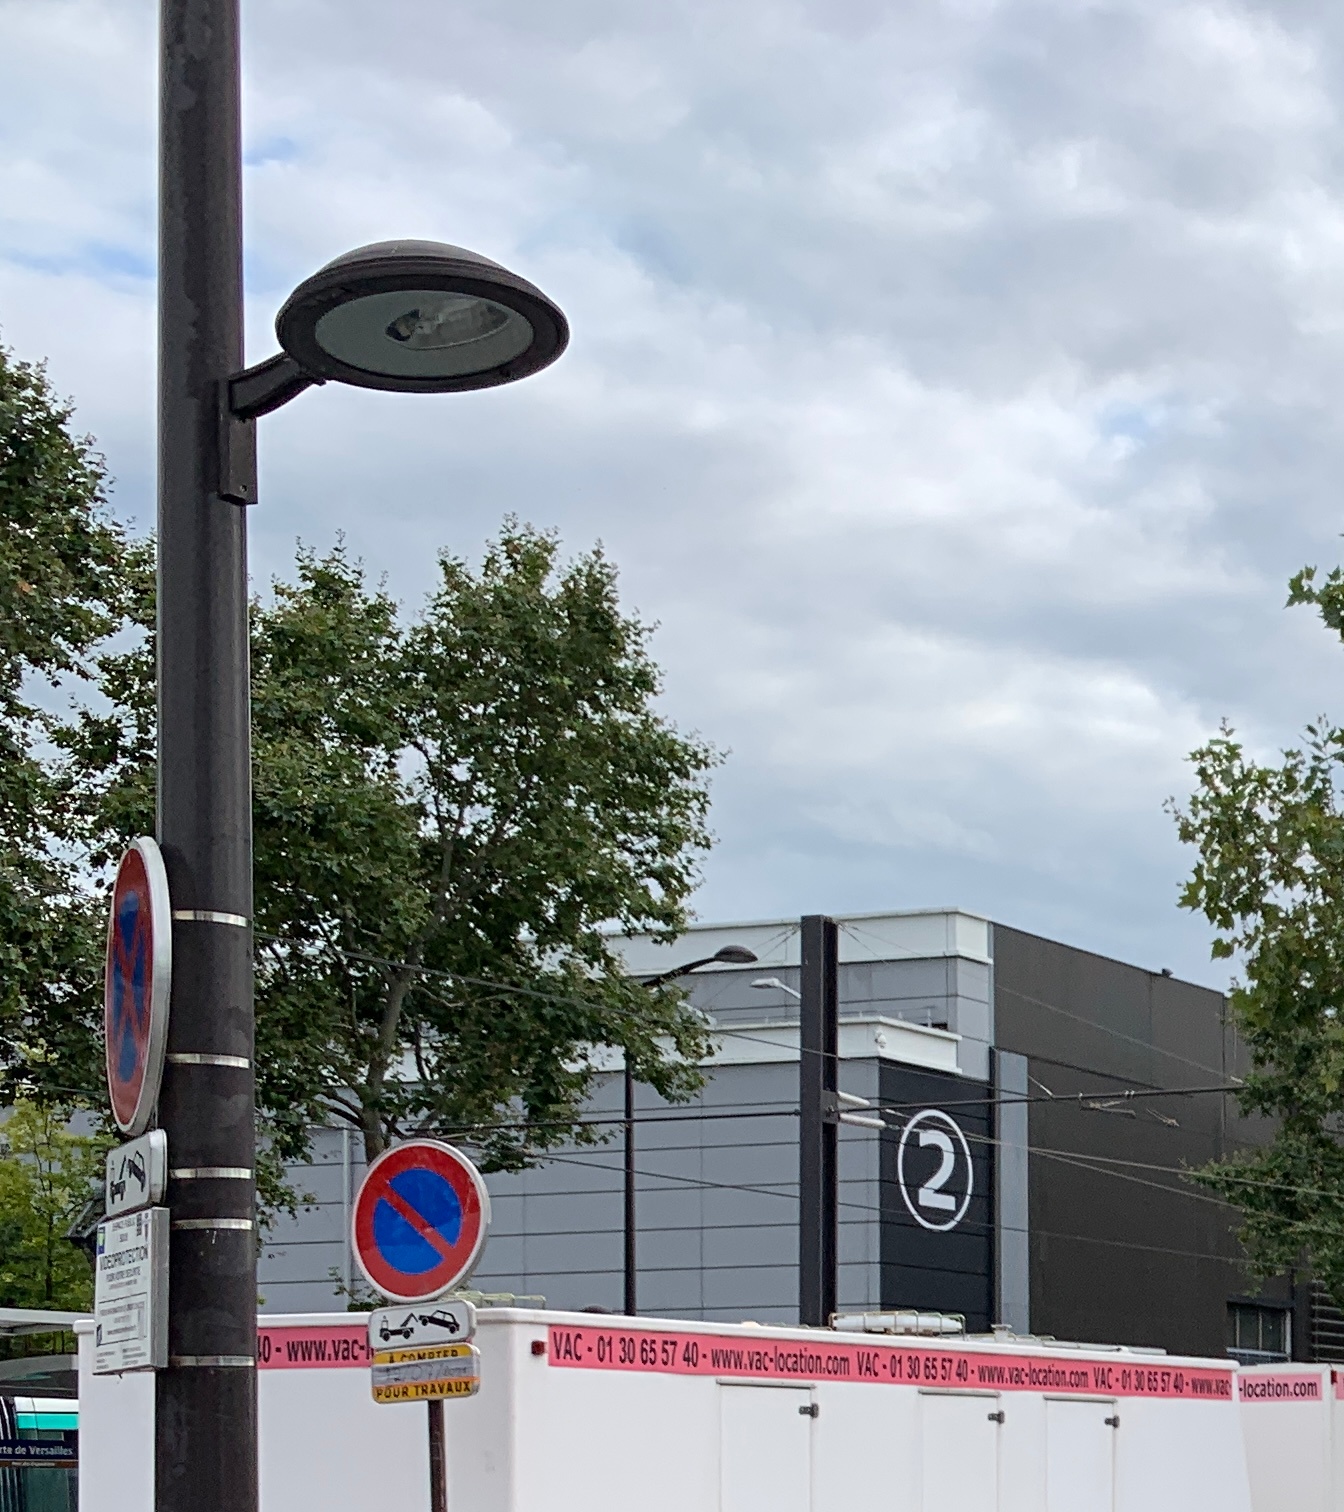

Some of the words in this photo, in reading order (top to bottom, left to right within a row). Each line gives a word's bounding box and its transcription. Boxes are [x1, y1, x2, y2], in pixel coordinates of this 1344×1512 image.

[918, 1129, 956, 1211] 2
[553, 1331, 583, 1361] VAC
[597, 1335, 613, 1363] 01
[619, 1337, 636, 1364] 30
[640, 1338, 657, 1365] 65
[661, 1339, 678, 1366] 57
[682, 1341, 699, 1367] 40
[711, 1345, 850, 1375] www.vac-location.com
[857, 1351, 880, 1377] VAC
[890, 1354, 903, 1378] 01
[907, 1355, 920, 1379] 30
[924, 1356, 938, 1380] 65
[941, 1357, 953, 1381] 57
[956, 1358, 968, 1382] 40
[978, 1361, 1089, 1388] www.vac-location.com
[1093, 1366, 1113, 1389] VAC
[1121, 1369, 1132, 1391] 01
[1134, 1369, 1145, 1391] 30
[1147, 1370, 1158, 1392] 65
[1161, 1371, 1171, 1392] 57
[1173, 1372, 1184, 1393] 40
[376, 1385, 409, 1398] POUR
[414, 1381, 470, 1396] TRAVAUX
[15, 1445, 27, 1454] de
[29, 1446, 73, 1455] Versailles
